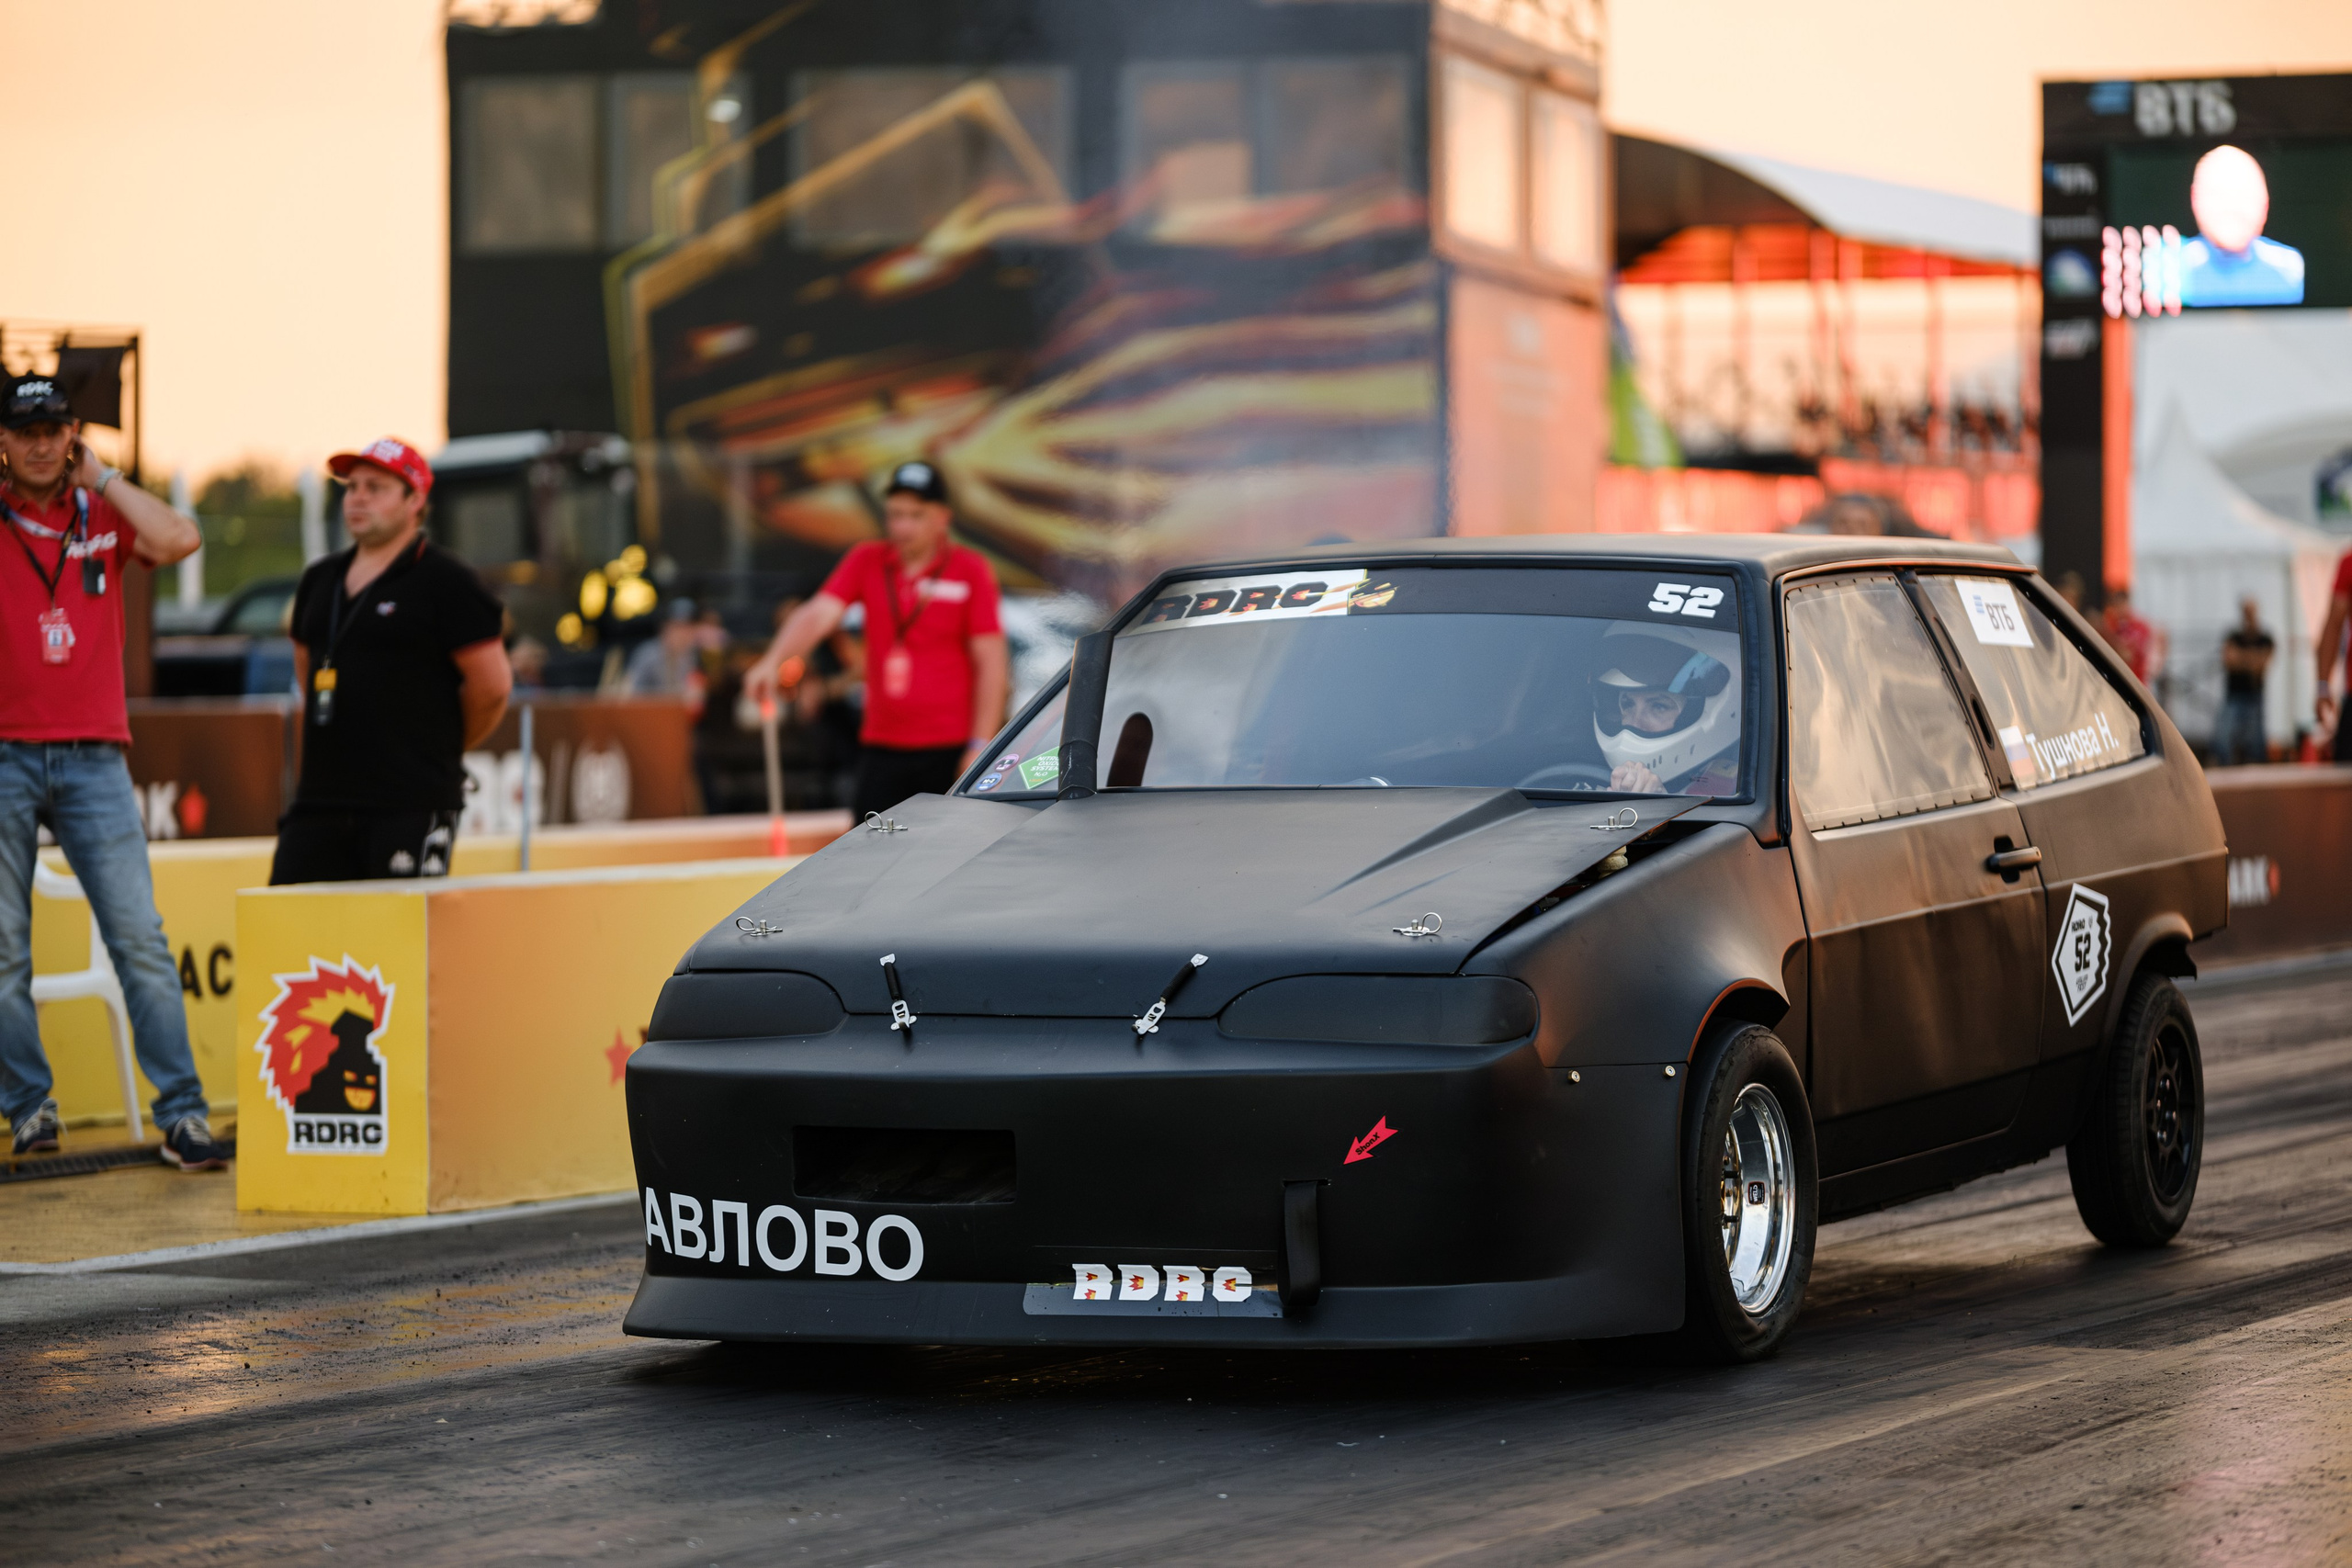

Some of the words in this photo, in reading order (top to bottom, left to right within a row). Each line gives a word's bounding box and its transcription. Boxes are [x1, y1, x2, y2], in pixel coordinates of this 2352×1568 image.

[1141, 581, 1329, 625] RDRC
[1647, 582, 1724, 618] 52
[1984, 602, 2015, 631] ВТБ
[2025, 732, 2102, 781] Тушнова
[2075, 932, 2091, 972] 52
[294, 1122, 383, 1145] RDRC
[1072, 1263, 1252, 1302] RDRC
